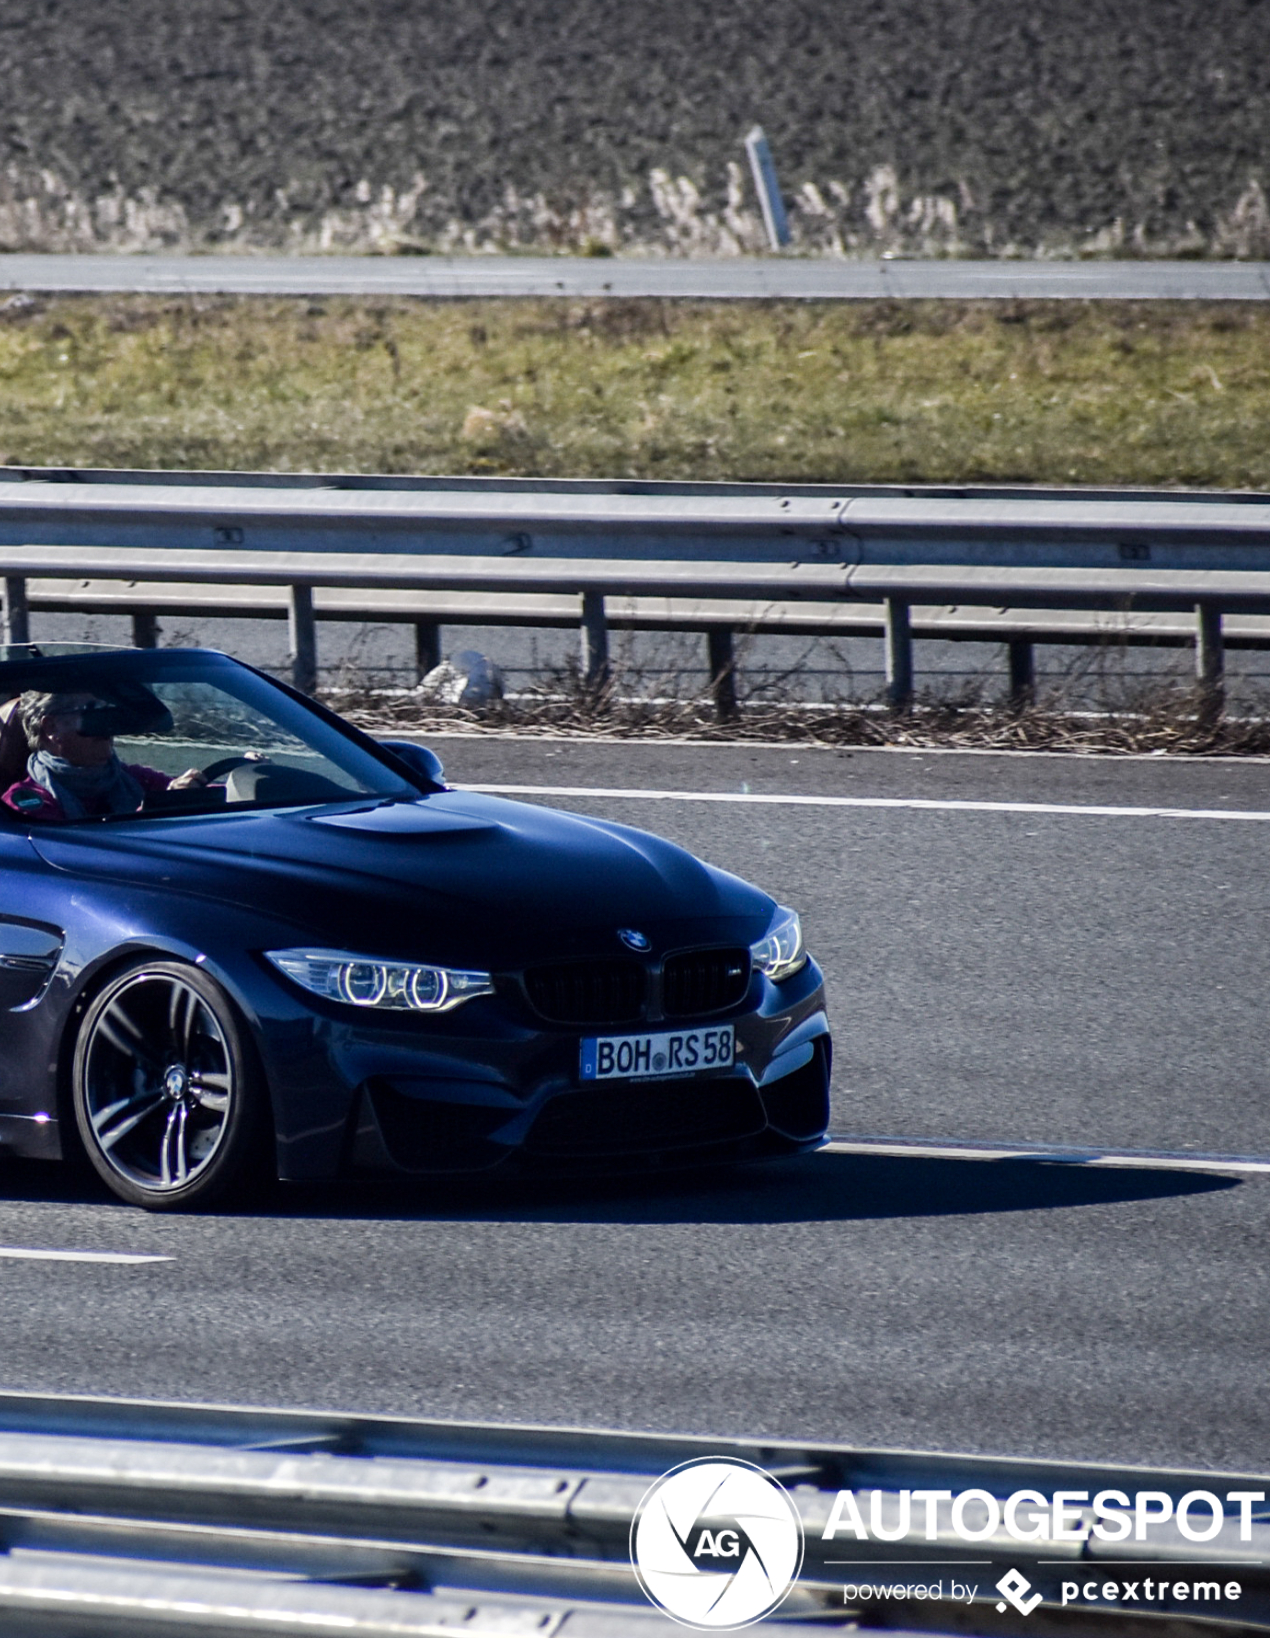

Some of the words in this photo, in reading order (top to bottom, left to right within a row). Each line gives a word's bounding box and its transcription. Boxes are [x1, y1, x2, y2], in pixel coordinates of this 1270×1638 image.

[597, 1038, 652, 1075] BOH
[668, 1034, 699, 1070] RS
[703, 1030, 731, 1065] 58
